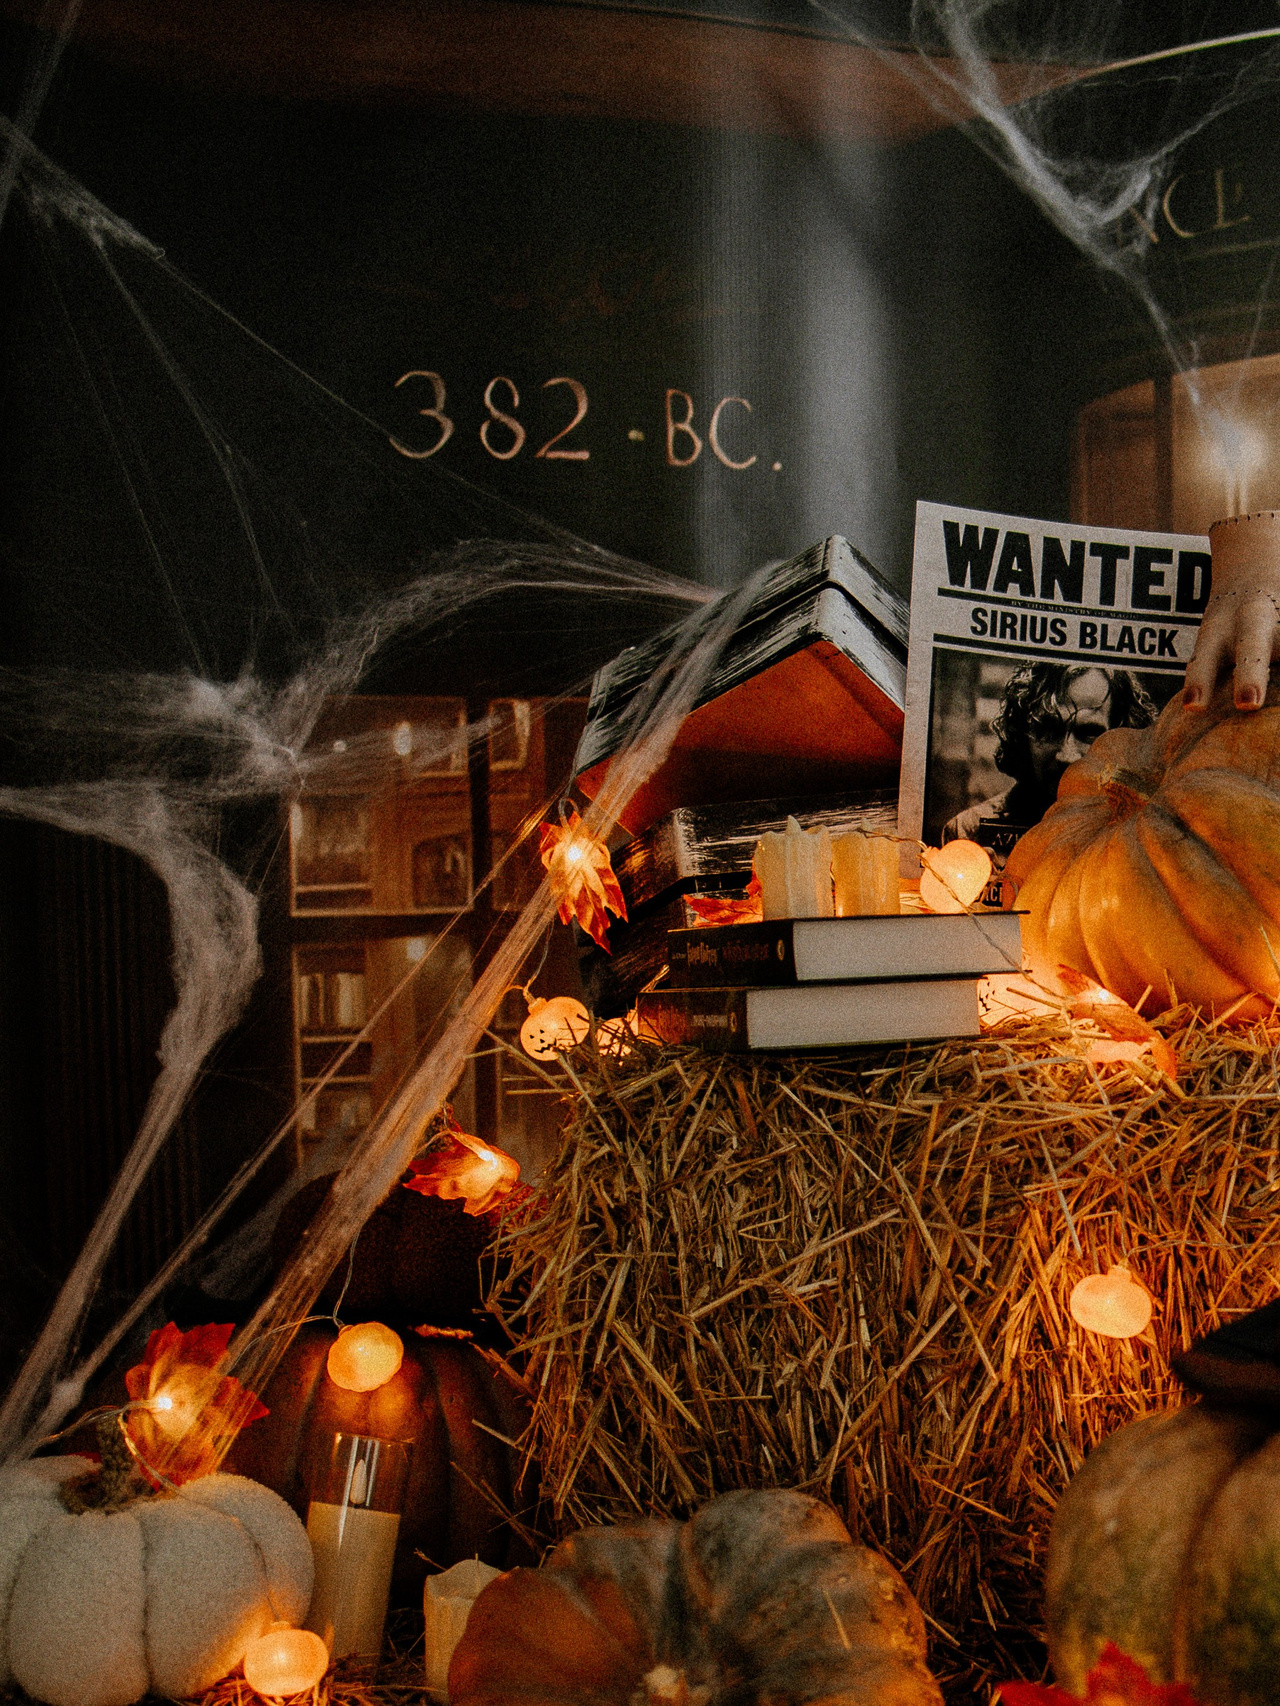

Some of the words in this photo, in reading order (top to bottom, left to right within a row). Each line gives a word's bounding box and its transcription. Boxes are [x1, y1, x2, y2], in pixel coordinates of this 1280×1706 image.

[389, 370, 591, 461] 382
[942, 519, 1213, 615] WANTED
[970, 607, 1067, 647] SIRIUS
[1079, 622, 1180, 658] BLACK
